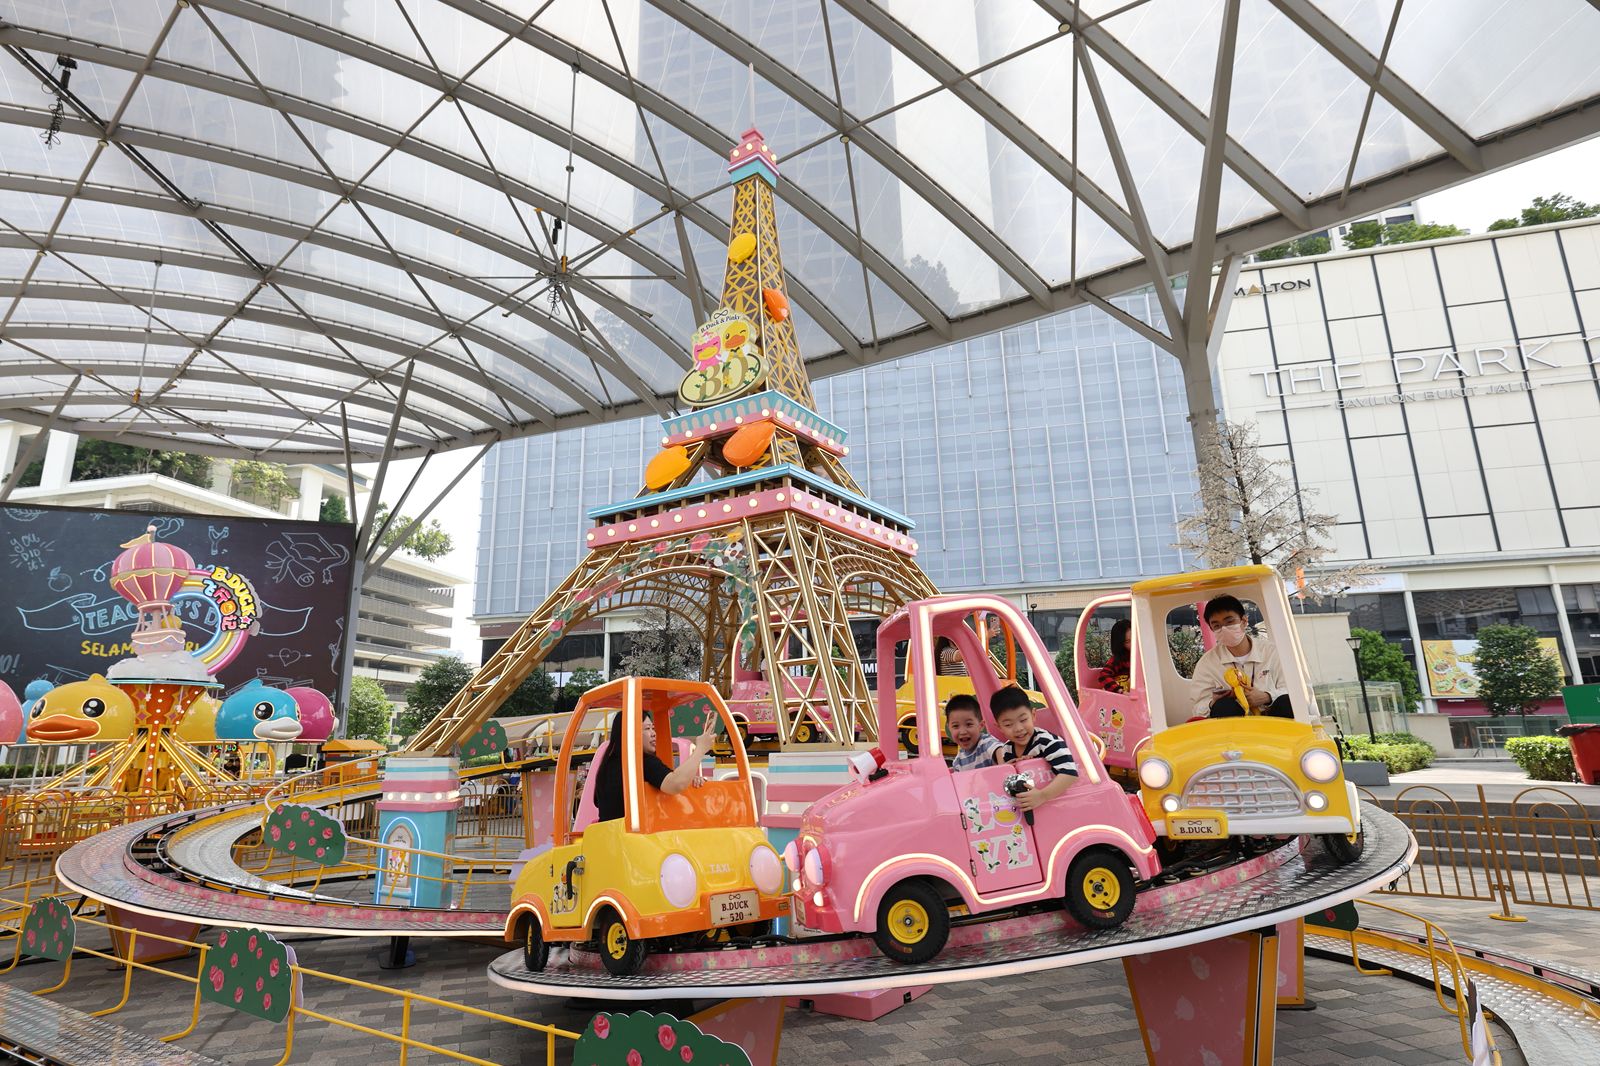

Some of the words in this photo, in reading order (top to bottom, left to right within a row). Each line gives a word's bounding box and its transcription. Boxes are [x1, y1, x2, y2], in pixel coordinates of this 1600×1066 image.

[1250, 362, 1365, 397] THE
[1393, 338, 1561, 384] PARK
[1335, 393, 1416, 409] PAVILION
[1424, 386, 1478, 400] BUKIT
[1486, 381, 1536, 395] JALIL
[85, 600, 202, 630] TEACR'S
[1180, 826, 1213, 834] B.DUCK
[710, 864, 731, 873] TAXI
[721, 900, 749, 912] B.DUCK
[729, 912, 744, 922] 520
